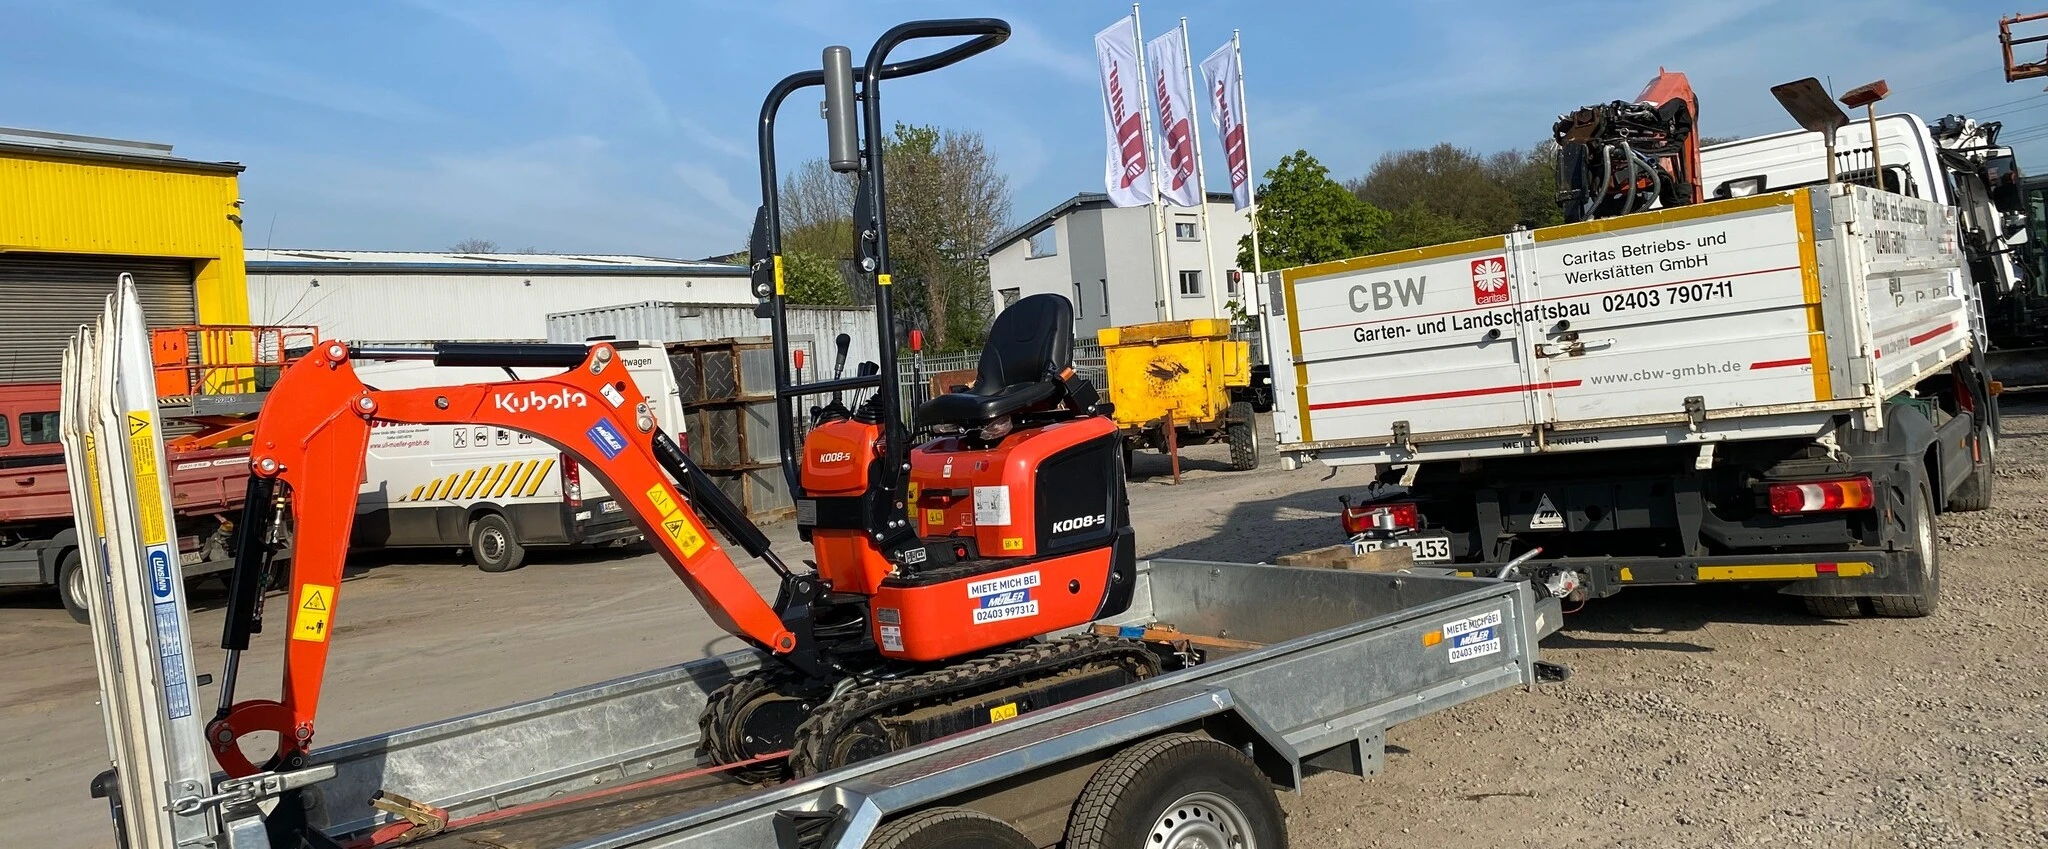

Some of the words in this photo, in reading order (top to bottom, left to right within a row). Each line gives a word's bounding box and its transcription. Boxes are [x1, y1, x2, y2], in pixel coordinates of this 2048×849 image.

[1562, 249, 1616, 267] Caritas
[1622, 239, 1692, 258] Betriebs-
[1697, 232, 1727, 247] und
[1564, 262, 1654, 285] Werkstätten
[1659, 254, 1709, 273] GmbH
[1348, 275, 1427, 313] CBW
[1477, 292, 1508, 305] caritas
[1353, 327, 1412, 343] Garten-
[1416, 316, 1447, 336] und
[1452, 301, 1591, 331] Landschaftsbau
[1602, 289, 1660, 313] 02403
[1666, 281, 1733, 305] 7907-11
[1590, 361, 1741, 385] www.cbw-gmbh.de
[494, 388, 587, 413] Kubota
[819, 452, 851, 463] K008-5
[1052, 514, 1105, 534] K008-5
[971, 581, 998, 595] MIETE
[999, 577, 1022, 592] MICH
[1024, 575, 1037, 589] BEI
[976, 608, 1003, 622] 02403
[1005, 604, 1035, 617] 997312
[1446, 621, 1468, 636] MIETE
[1468, 616, 1487, 630] MICH
[1487, 613, 1499, 625] BEI
[1451, 648, 1473, 660] 02403
[1474, 641, 1498, 655] 997312
